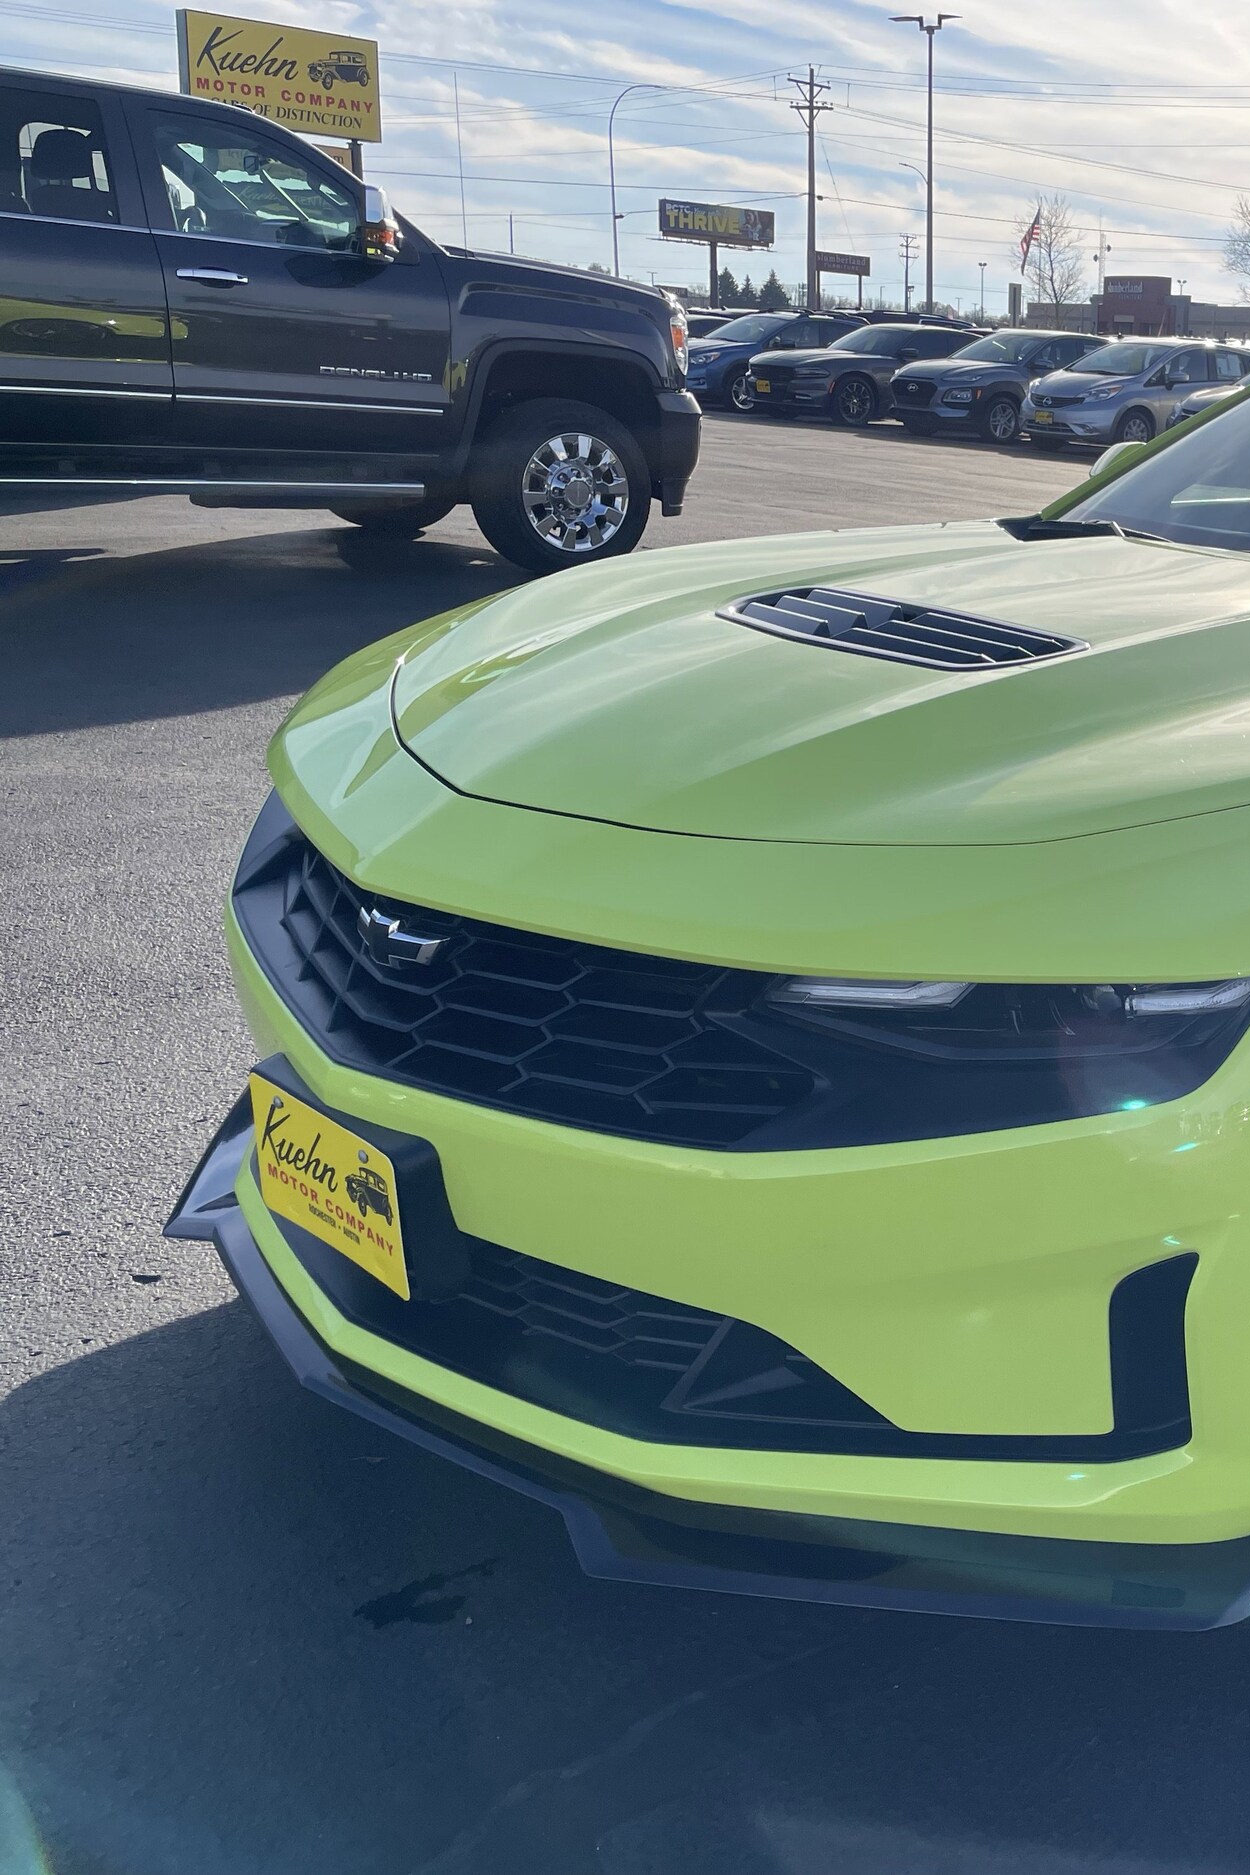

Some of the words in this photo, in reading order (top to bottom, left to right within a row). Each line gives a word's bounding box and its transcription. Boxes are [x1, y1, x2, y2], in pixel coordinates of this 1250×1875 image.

[197, 27, 299, 80] Kuehn
[197, 77, 265, 98] MOTOR
[281, 89, 373, 113] COMPANY
[252, 103, 271, 116] OF
[276, 106, 363, 129] DISTINCTION
[666, 210, 741, 234] THRIVE
[817, 253, 866, 266] slumberland
[319, 366, 399, 380] DENALI
[402, 372, 432, 382] HD
[261, 1103, 338, 1193] Kuehn
[267, 1162, 319, 1205] MOTOR
[325, 1198, 393, 1256] COMPANY
